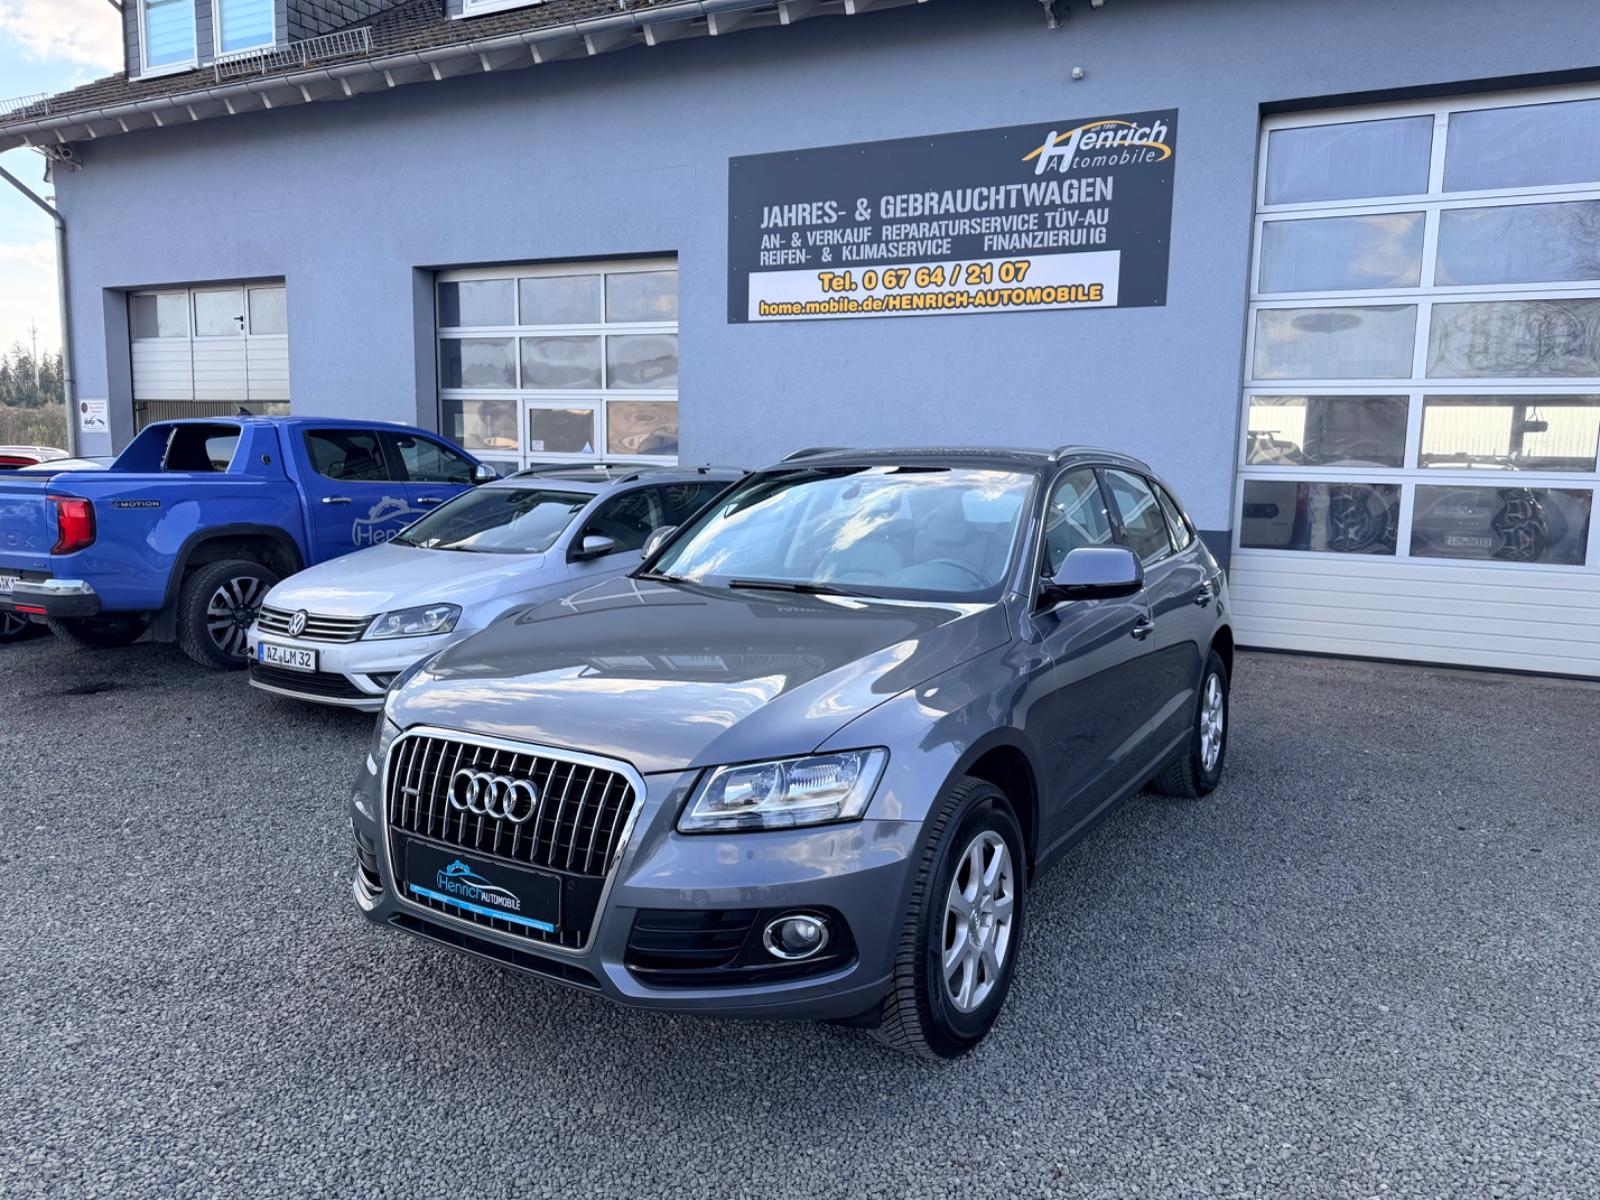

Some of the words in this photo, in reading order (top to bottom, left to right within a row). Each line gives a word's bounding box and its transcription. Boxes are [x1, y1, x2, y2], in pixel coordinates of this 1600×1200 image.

[1034, 120, 1168, 176] Henrich
[760, 200, 847, 229] JAHRES-
[854, 198, 872, 222] &
[880, 176, 1113, 219] GEBRAUCHTWAGEN
[761, 233, 786, 250] AN-
[791, 232, 802, 248] &
[806, 226, 872, 247] VERKAUF
[882, 213, 1039, 242] REPARATURSERVICE
[1044, 207, 1109, 230] TÜV-AU
[760, 248, 811, 267] REIFEN-
[821, 246, 832, 263] &
[842, 238, 952, 262] KLIMASERVICE
[818, 271, 858, 293] Tel.
[862, 269, 878, 291] 0
[882, 267, 911, 289] 67
[914, 265, 946, 287] 64
[949, 263, 962, 287] /
[965, 262, 994, 286] 21
[998, 259, 1031, 284] 07
[759, 284, 1103, 315] home.mobile.de/HENRICH-AUTOMOBILE
[266, 646, 278, 662] AZ
[284, 649, 297, 665] LM
[298, 651, 311, 668] 32
[439, 876, 483, 900] Henrich
[481, 891, 521, 911] AUTOMOBILE
